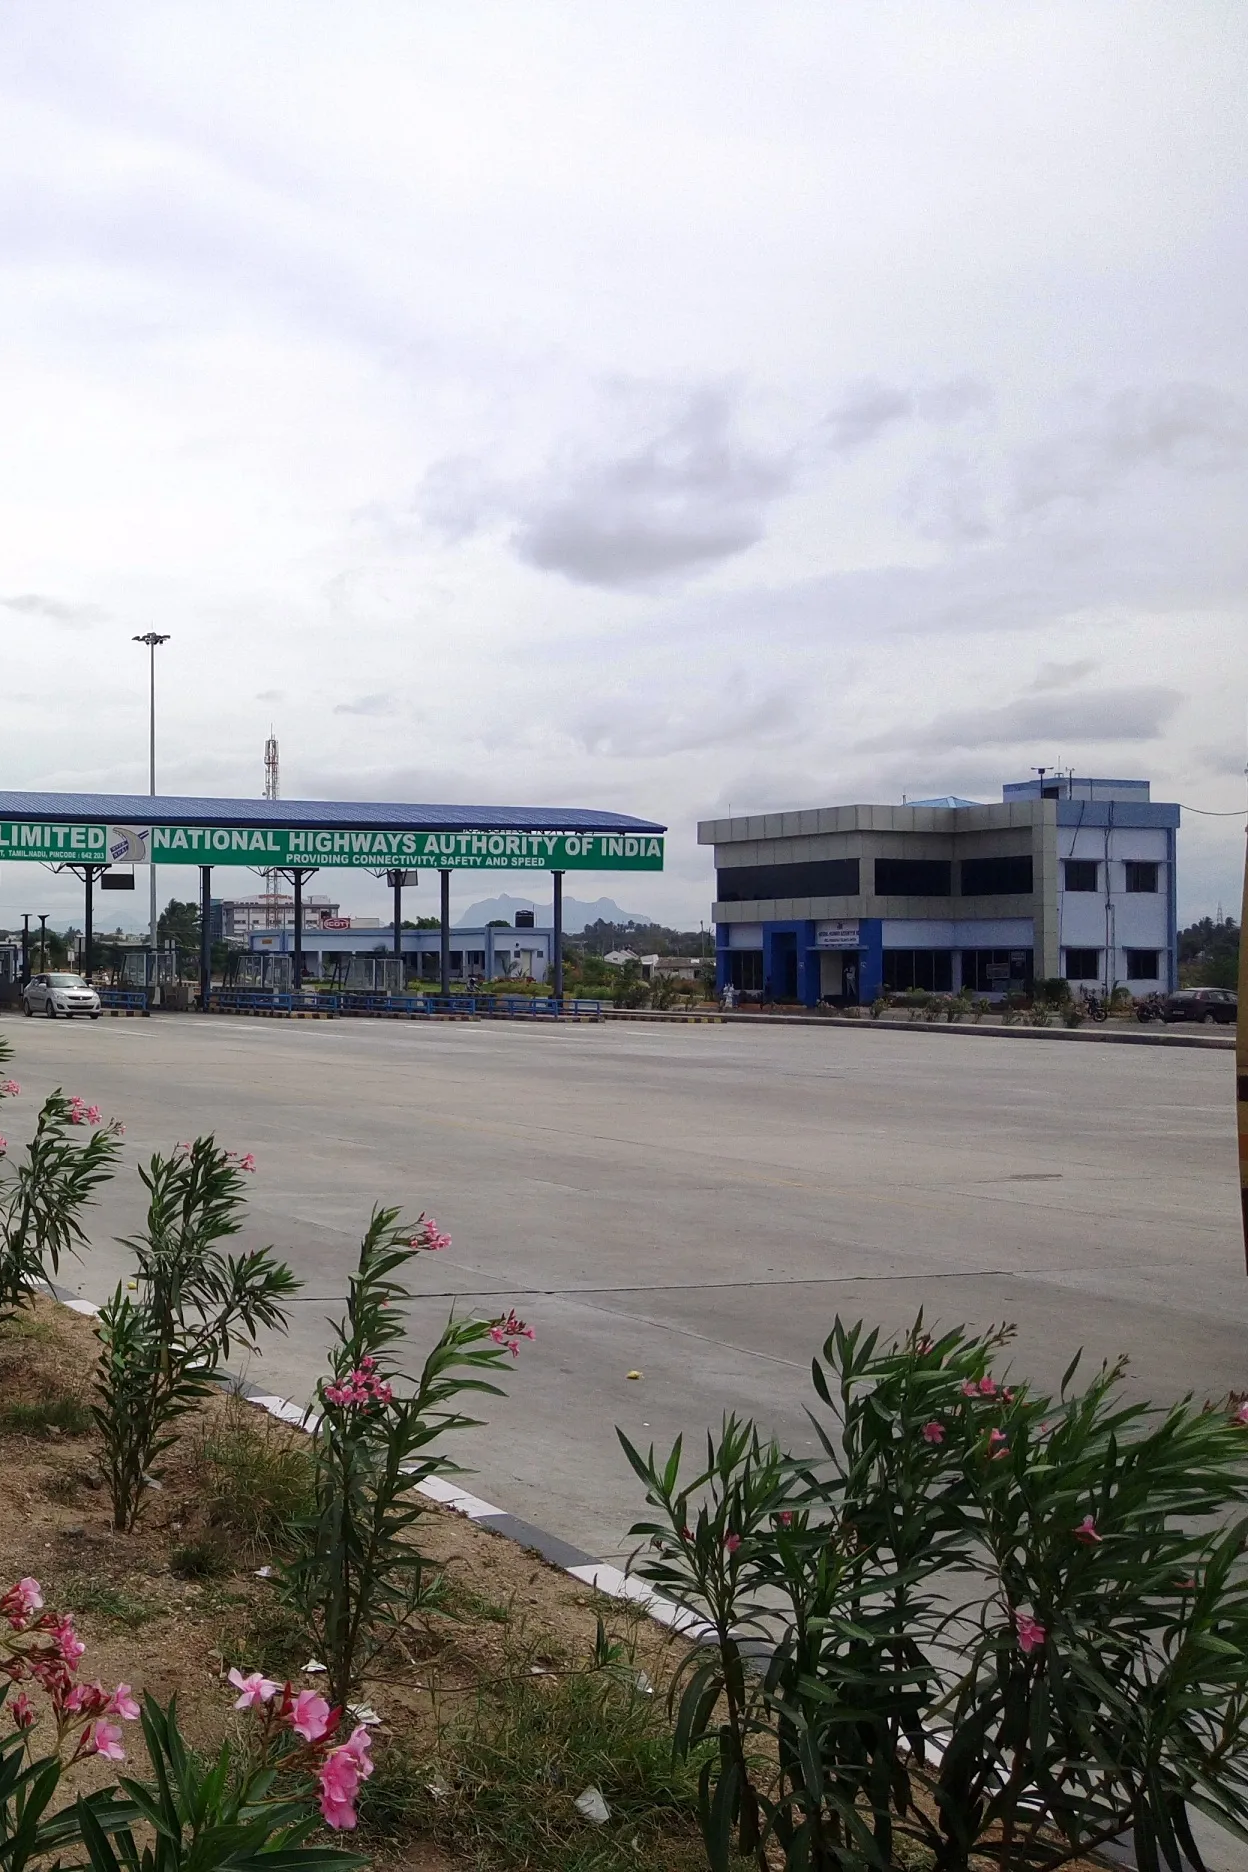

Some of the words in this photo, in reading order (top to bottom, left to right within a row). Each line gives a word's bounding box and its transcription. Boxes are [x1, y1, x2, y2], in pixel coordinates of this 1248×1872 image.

[153, 828, 281, 851] NATIONAL
[288, 831, 417, 853] HIGHWAYS
[424, 834, 558, 856] AUTHORITY
[564, 836, 594, 856] OF
[601, 837, 661, 857] INDIA
[49, 851, 76, 859] PINCODE
[286, 853, 349, 864] PROVIDING
[352, 854, 437, 866] CONNECTIVITY,
[441, 856, 483, 866] SAFETY
[485, 857, 508, 866] AND
[511, 857, 545, 867] SPEED
